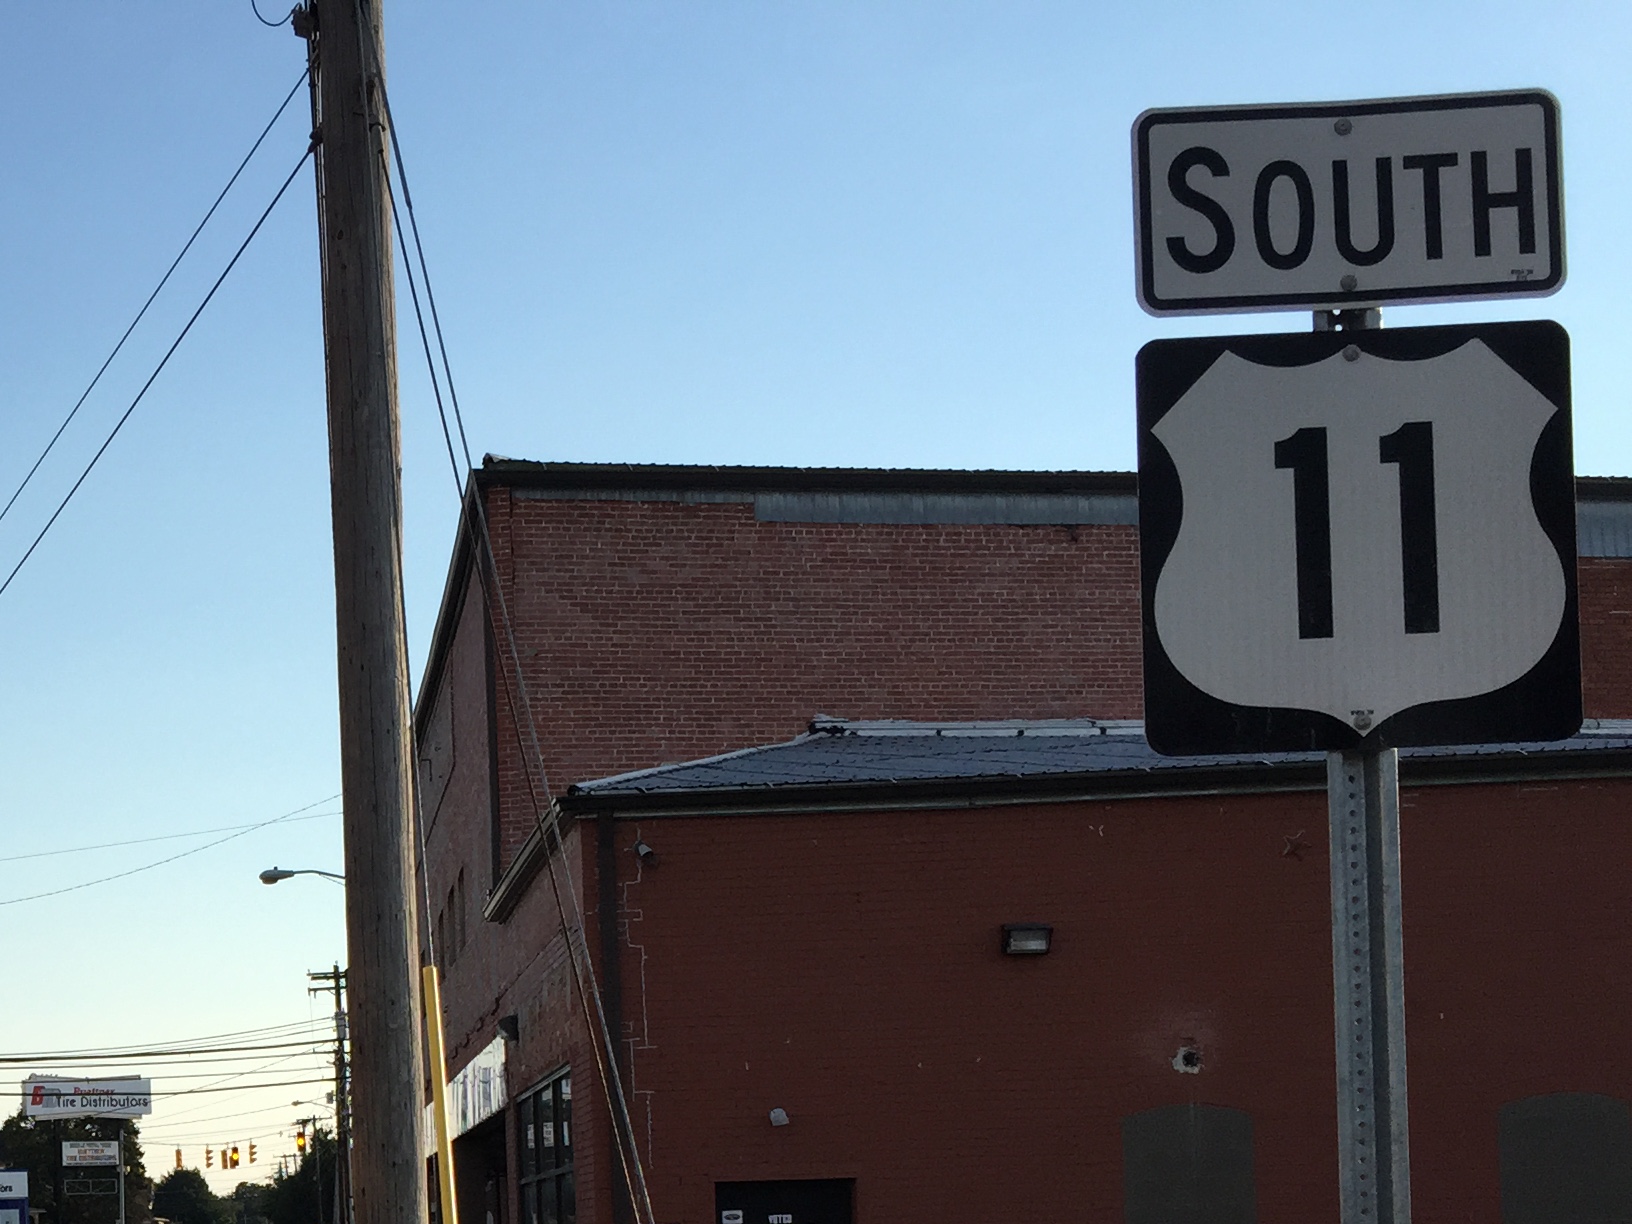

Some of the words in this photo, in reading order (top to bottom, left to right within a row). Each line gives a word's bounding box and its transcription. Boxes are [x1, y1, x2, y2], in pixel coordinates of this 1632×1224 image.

[1166, 146, 1537, 275] SOUTH
[1273, 420, 1441, 640] 11
[80, 1095, 149, 1108] Distributors
